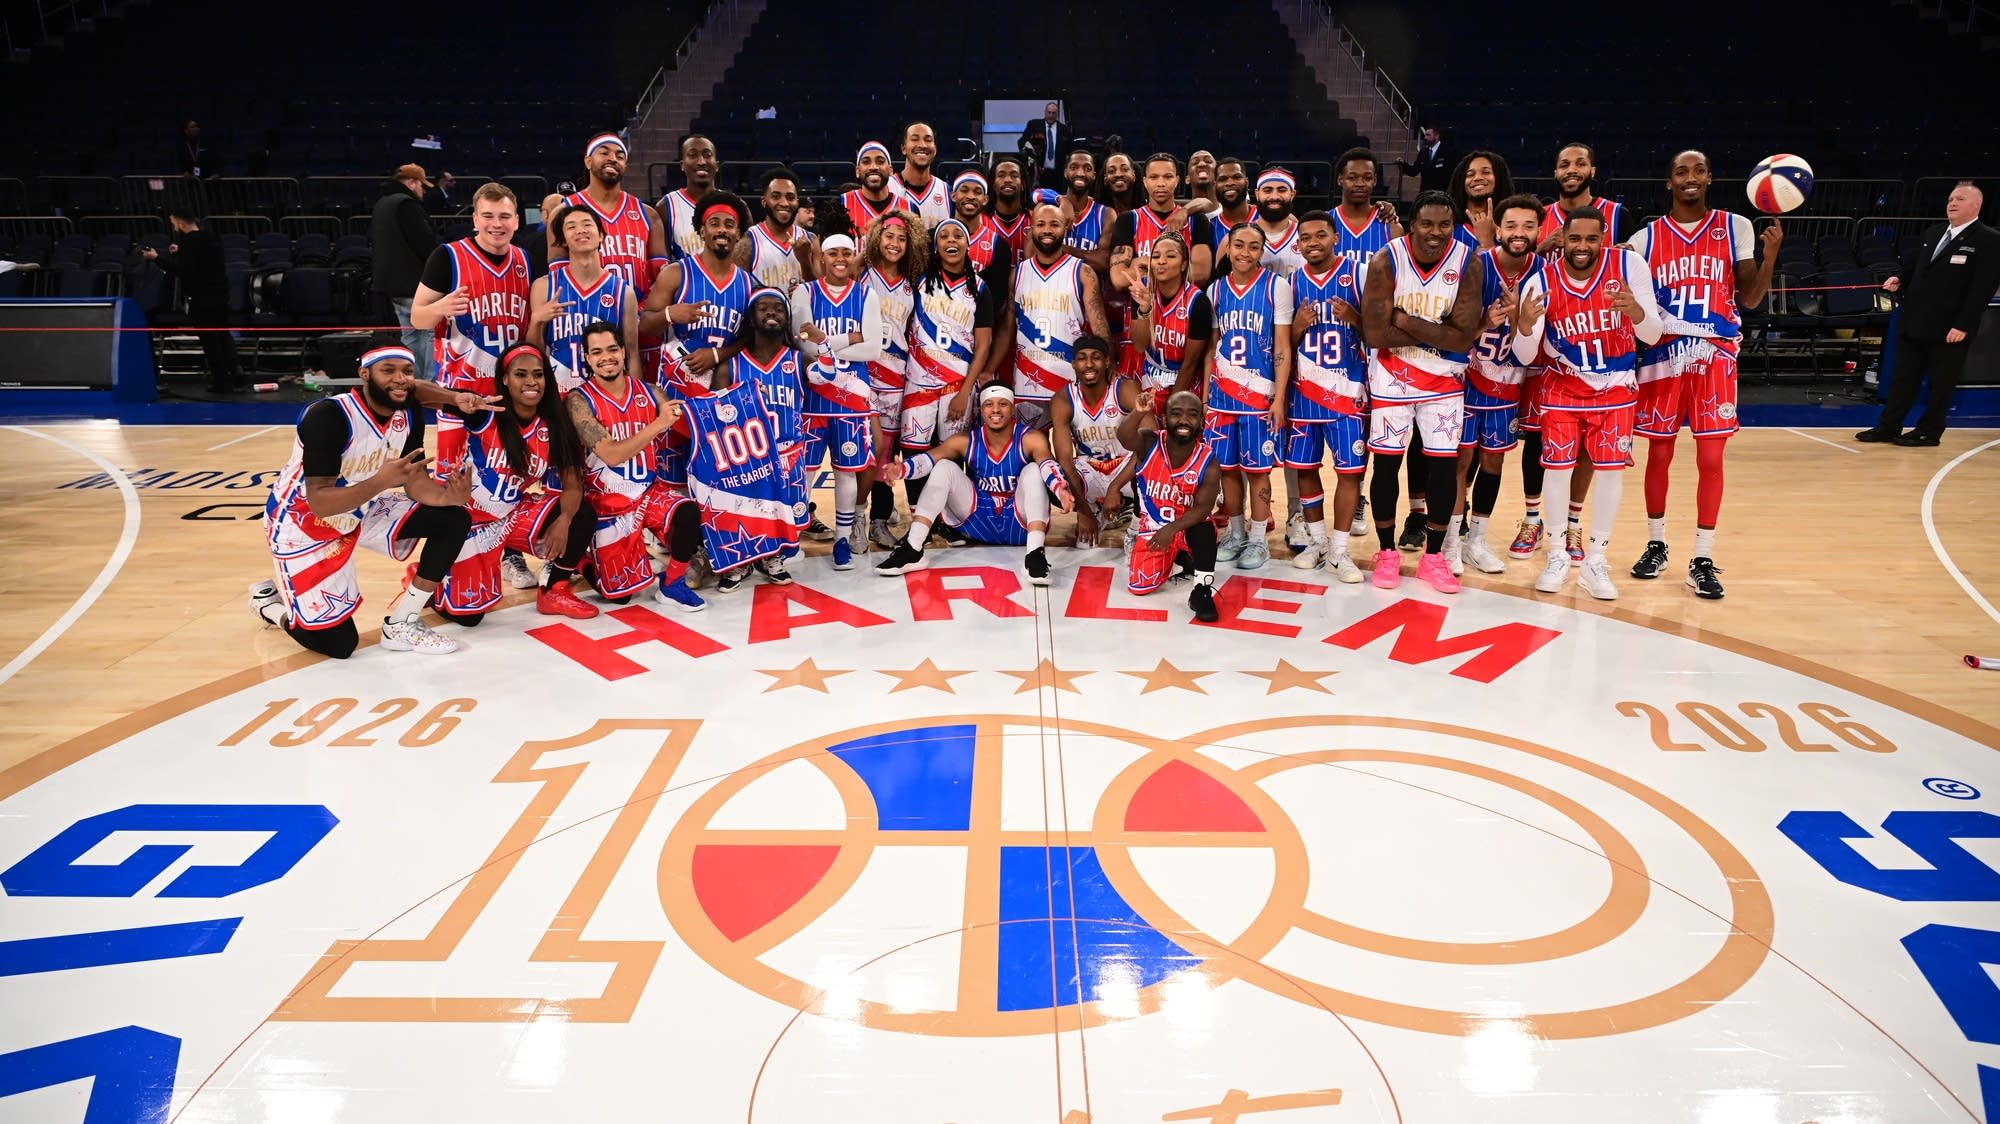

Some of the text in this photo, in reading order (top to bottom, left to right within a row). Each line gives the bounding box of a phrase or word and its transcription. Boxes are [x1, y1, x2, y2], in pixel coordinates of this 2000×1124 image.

[1657, 255, 1724, 289] HARLEM
[469, 292, 527, 324] HARLEM
[1020, 290, 1070, 315] HARLEM
[1669, 284, 1711, 320] 44
[936, 321, 952, 350] 6
[1033, 316, 1051, 349] 3
[1154, 325, 1186, 348] RLEM
[1219, 310, 1264, 335] HARLEM
[1554, 309, 1622, 340] HARLEM
[1230, 335, 1247, 367] 2
[1304, 330, 1341, 366] 43
[1578, 339, 1606, 371] 11
[706, 418, 770, 472] 100
[55, 467, 279, 490] MADIS
[485, 447, 548, 478] HAEM
[721, 475, 741, 489] THE
[741, 462, 774, 486] GARDEN
[490, 473, 525, 502] 18
[524, 565, 1563, 685] HARLEM
[217, 697, 478, 748] 1926
[1615, 701, 1897, 754] 2026
